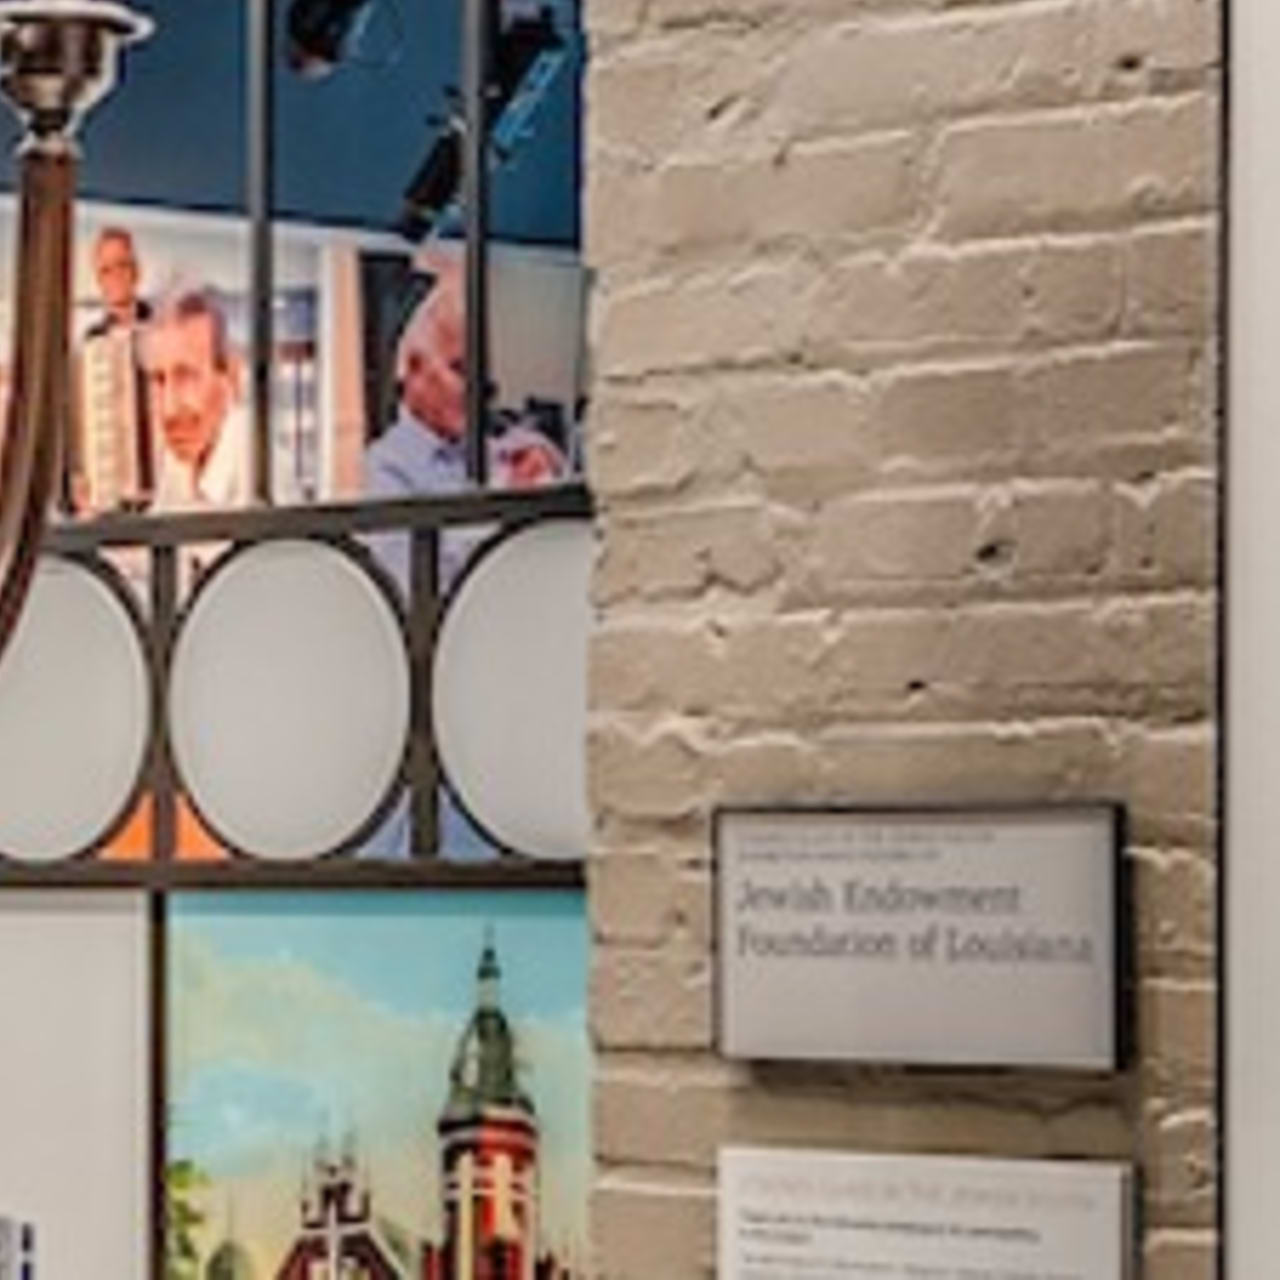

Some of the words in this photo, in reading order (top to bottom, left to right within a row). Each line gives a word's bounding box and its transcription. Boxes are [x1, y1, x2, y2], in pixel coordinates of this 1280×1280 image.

[737, 878, 835, 915] Jewish
[843, 878, 1024, 915] Endowment
[737, 923, 899, 961] Foundation
[906, 923, 945, 961] of
[945, 927, 1094, 964] Louisiana
